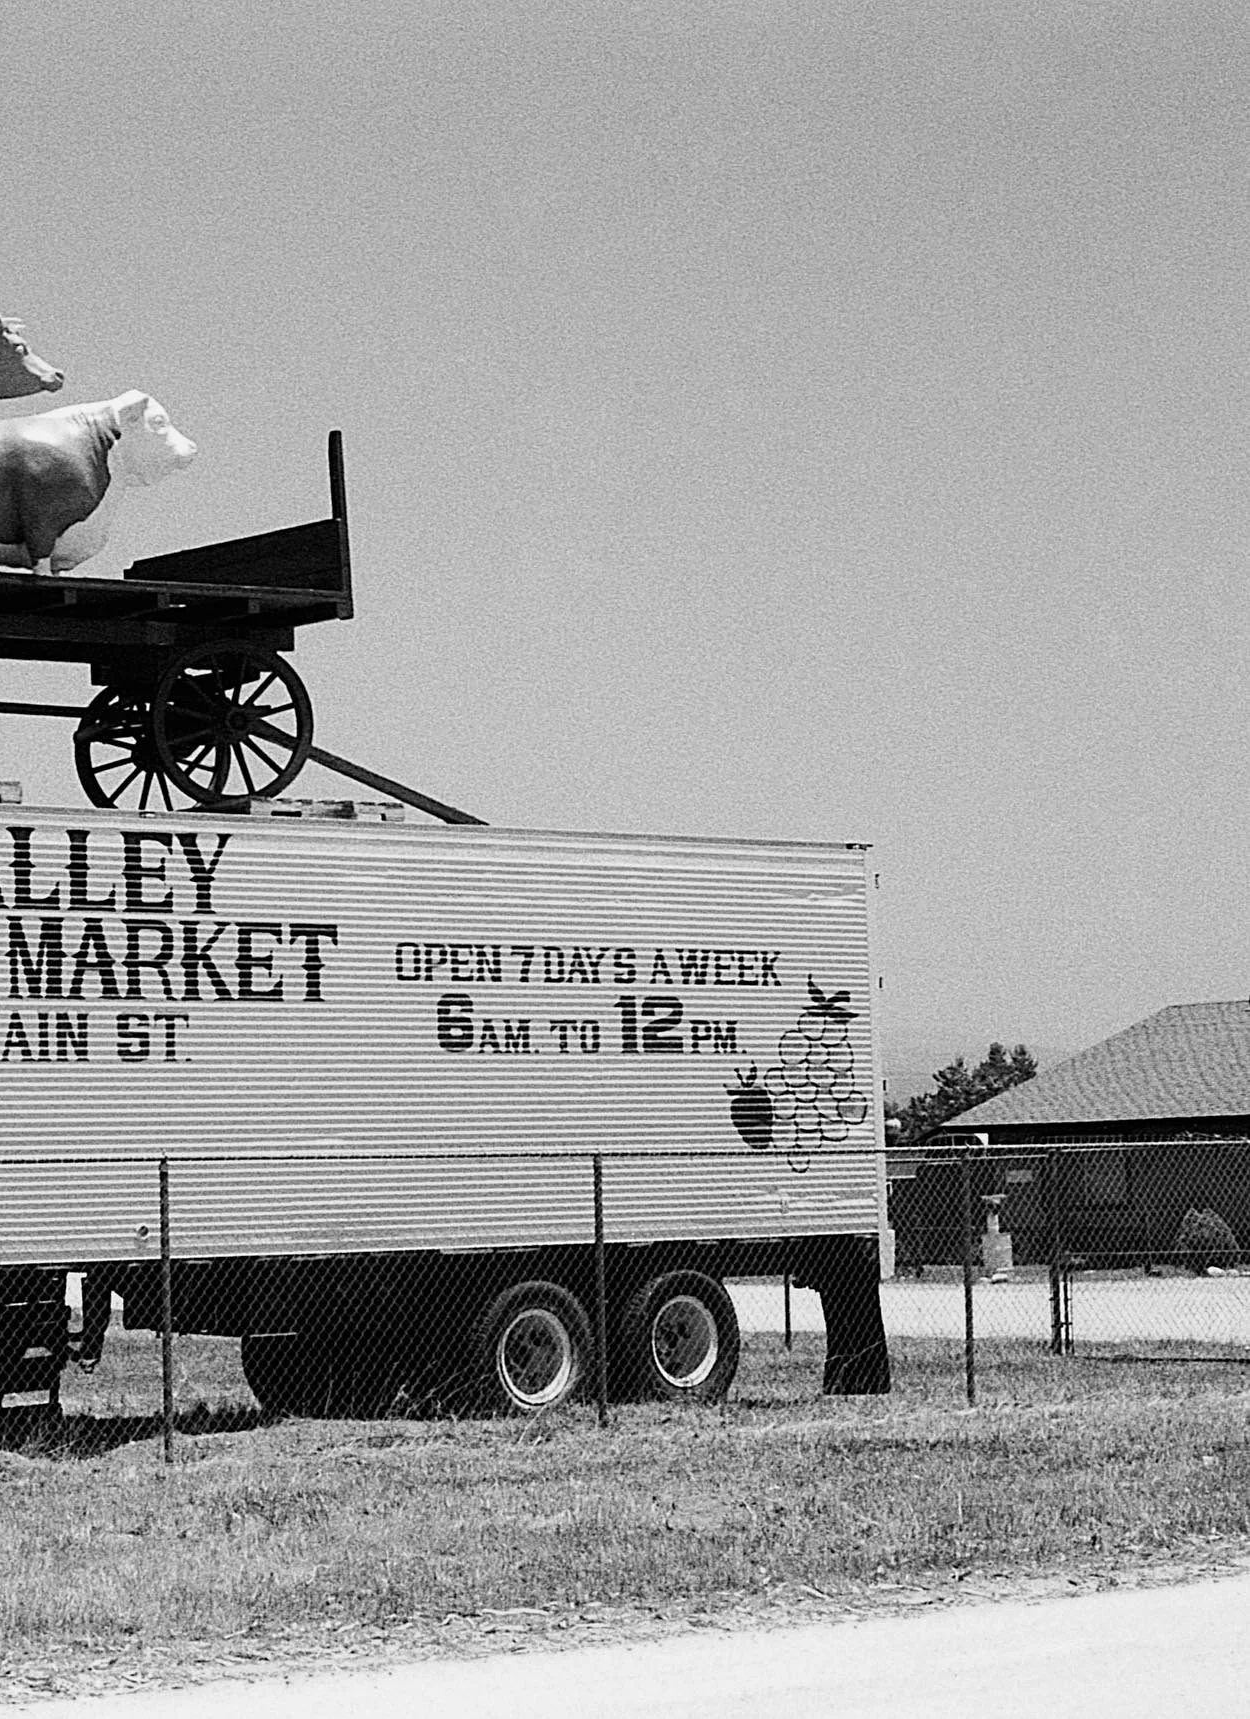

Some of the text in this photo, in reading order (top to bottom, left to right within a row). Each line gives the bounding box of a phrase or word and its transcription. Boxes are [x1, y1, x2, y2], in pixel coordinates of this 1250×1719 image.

[4, 916, 338, 1001] MARKET
[395, 942, 502, 982] OPEN
[510, 945, 535, 983] 7
[650, 948, 674, 985] A
[675, 949, 782, 987] WEEK
[116, 1014, 192, 1063] ST.
[549, 1019, 601, 1054] TO
